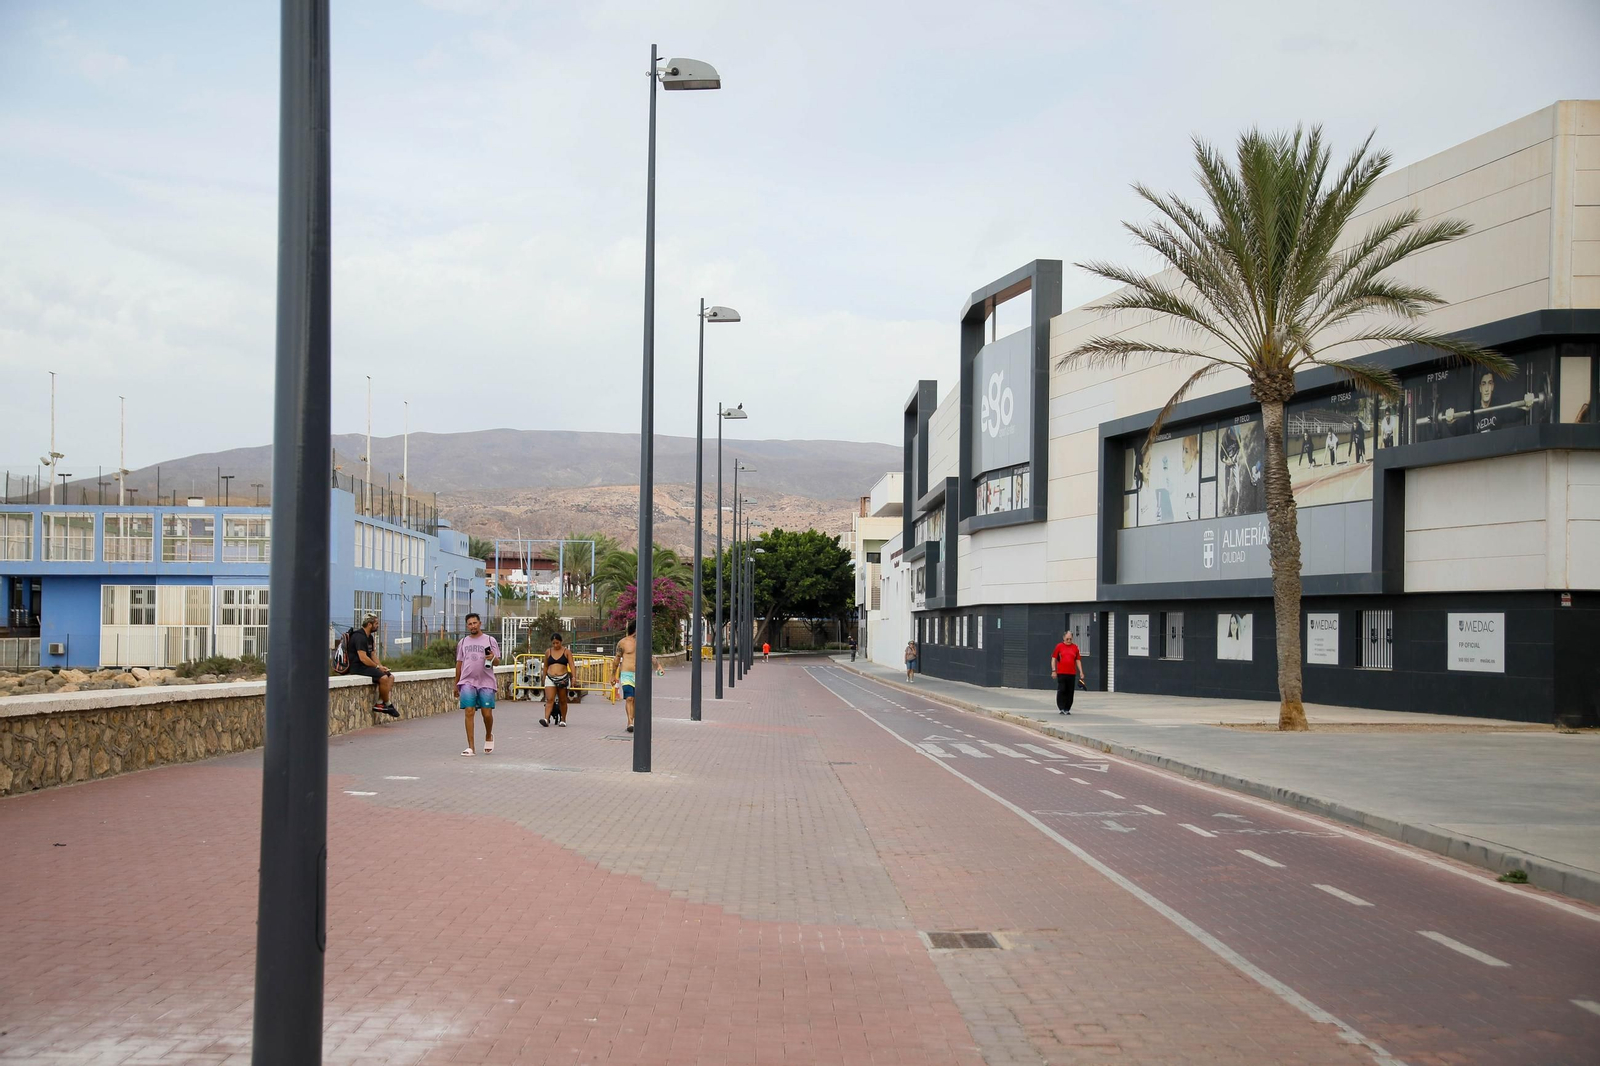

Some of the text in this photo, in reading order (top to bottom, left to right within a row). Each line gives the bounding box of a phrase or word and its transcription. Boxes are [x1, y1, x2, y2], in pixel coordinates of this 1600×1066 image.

[1427, 370, 1449, 383] FP TSAF
[981, 370, 1014, 438] ego
[1222, 522, 1269, 549] ALMERÍA
[1222, 551, 1246, 564] CIUDAD
[1315, 619, 1338, 630] MEDAC
[1464, 620, 1495, 632] MEDAC
[464, 644, 485, 654] PARIS
